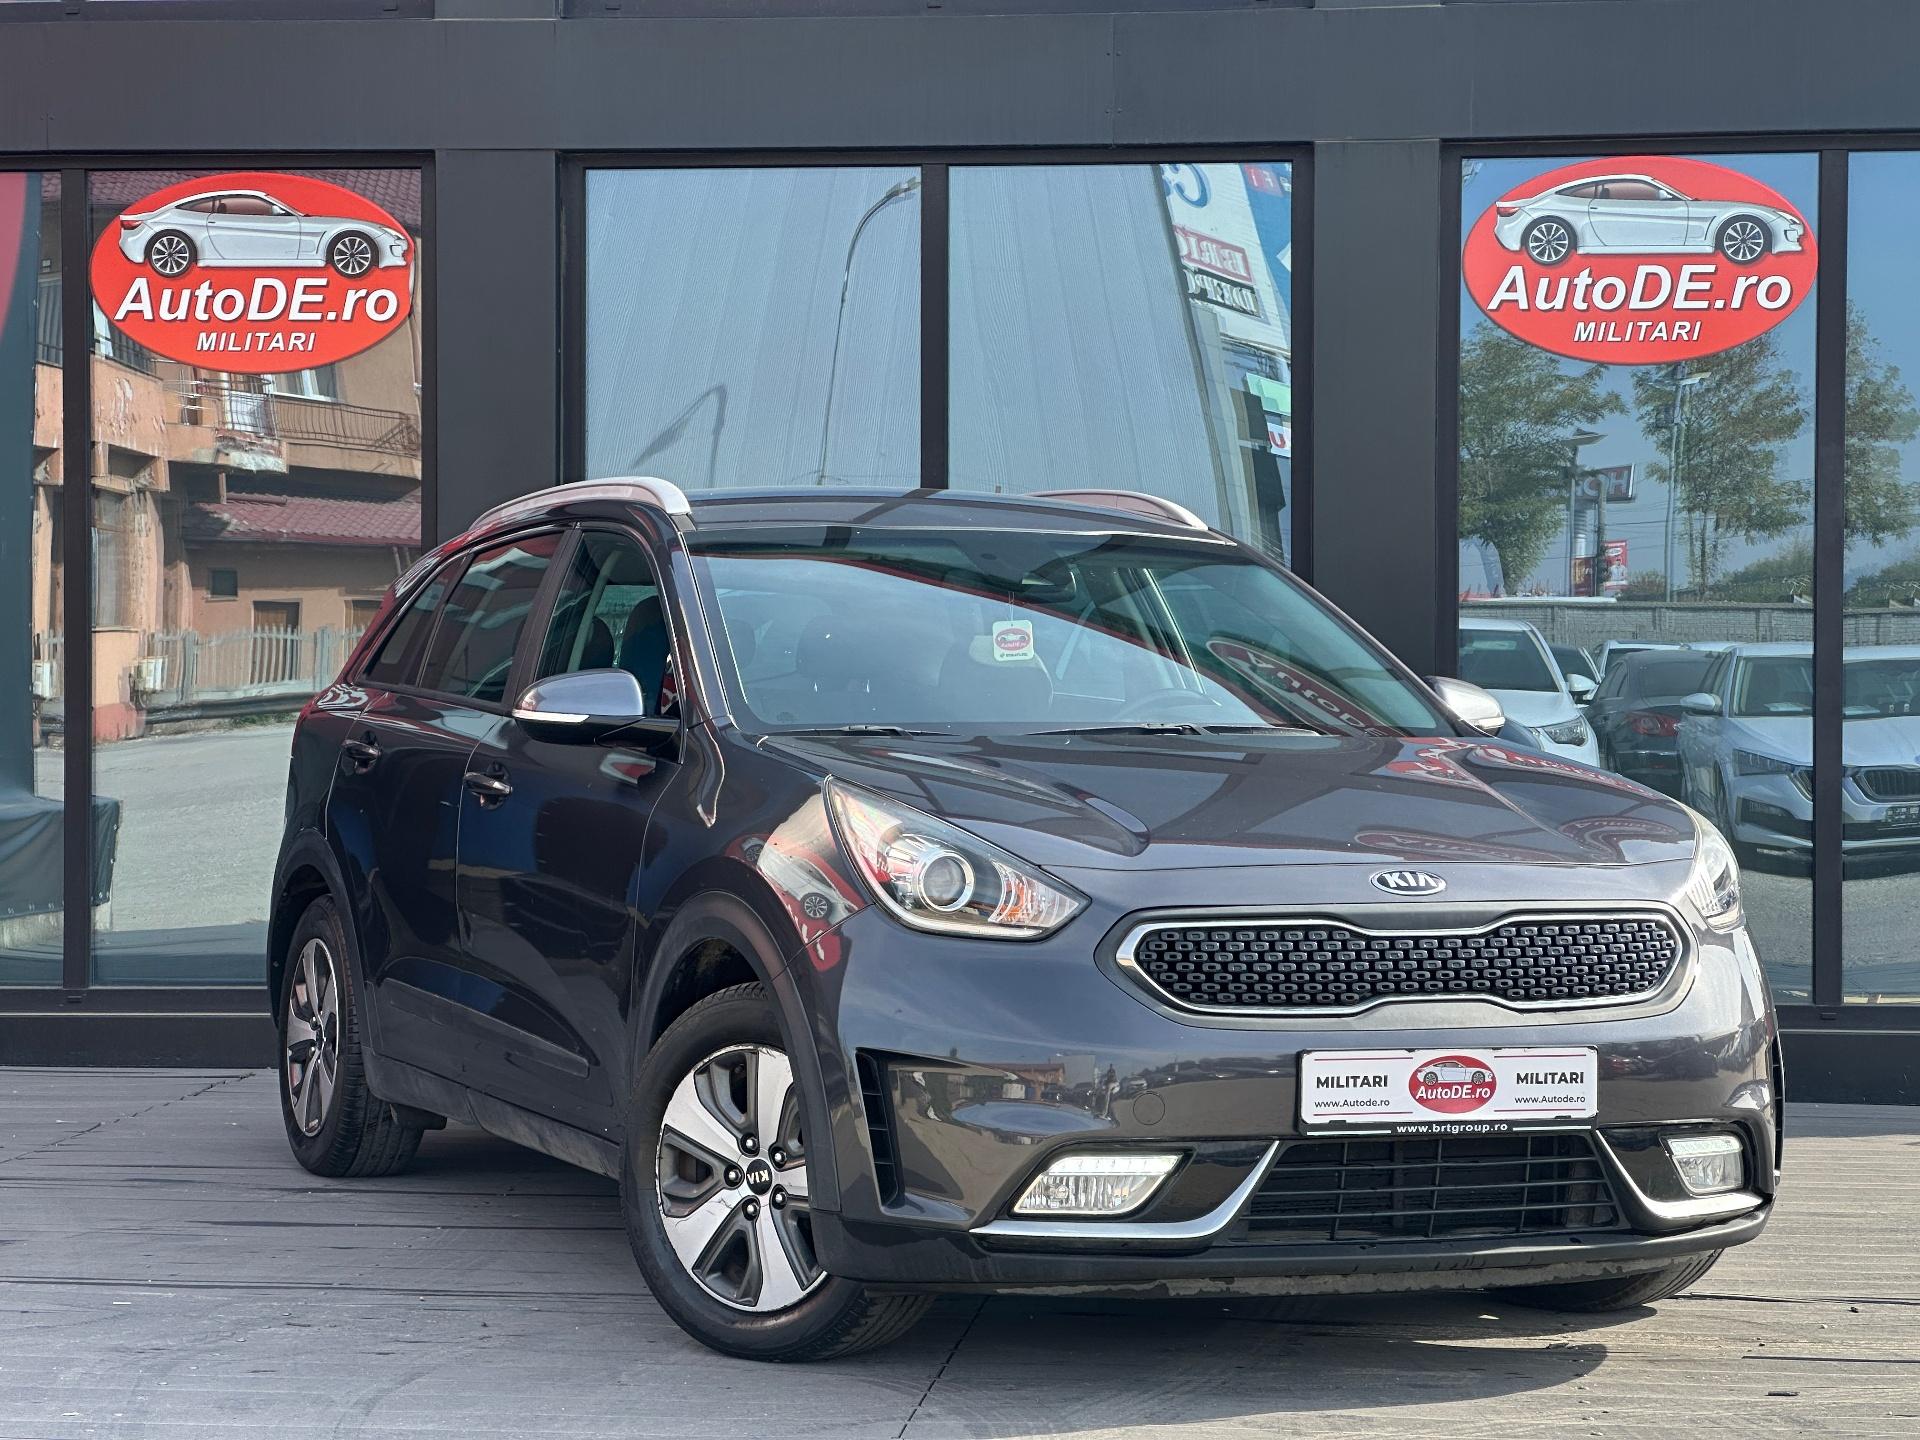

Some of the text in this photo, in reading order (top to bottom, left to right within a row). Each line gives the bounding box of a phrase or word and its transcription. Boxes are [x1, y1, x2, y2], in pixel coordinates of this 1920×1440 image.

[1487, 264, 1793, 311] AutoDE.ro
[114, 277, 399, 321] AutoDE.ro
[1574, 320, 1702, 343] MILITARI
[196, 331, 315, 351] MILITARI
[1382, 871, 1438, 888] KIA
[1316, 1075, 1388, 1089] MILITARI
[1516, 1071, 1584, 1086] MILITARI
[1415, 1083, 1491, 1100] AutoDE.ro
[1514, 1094, 1586, 1104] www.Autode.ro
[1314, 1098, 1390, 1108] www.Autode.ro
[1396, 1122, 1508, 1135] www.brtgroup.ro
[747, 1169, 770, 1185] KIA
